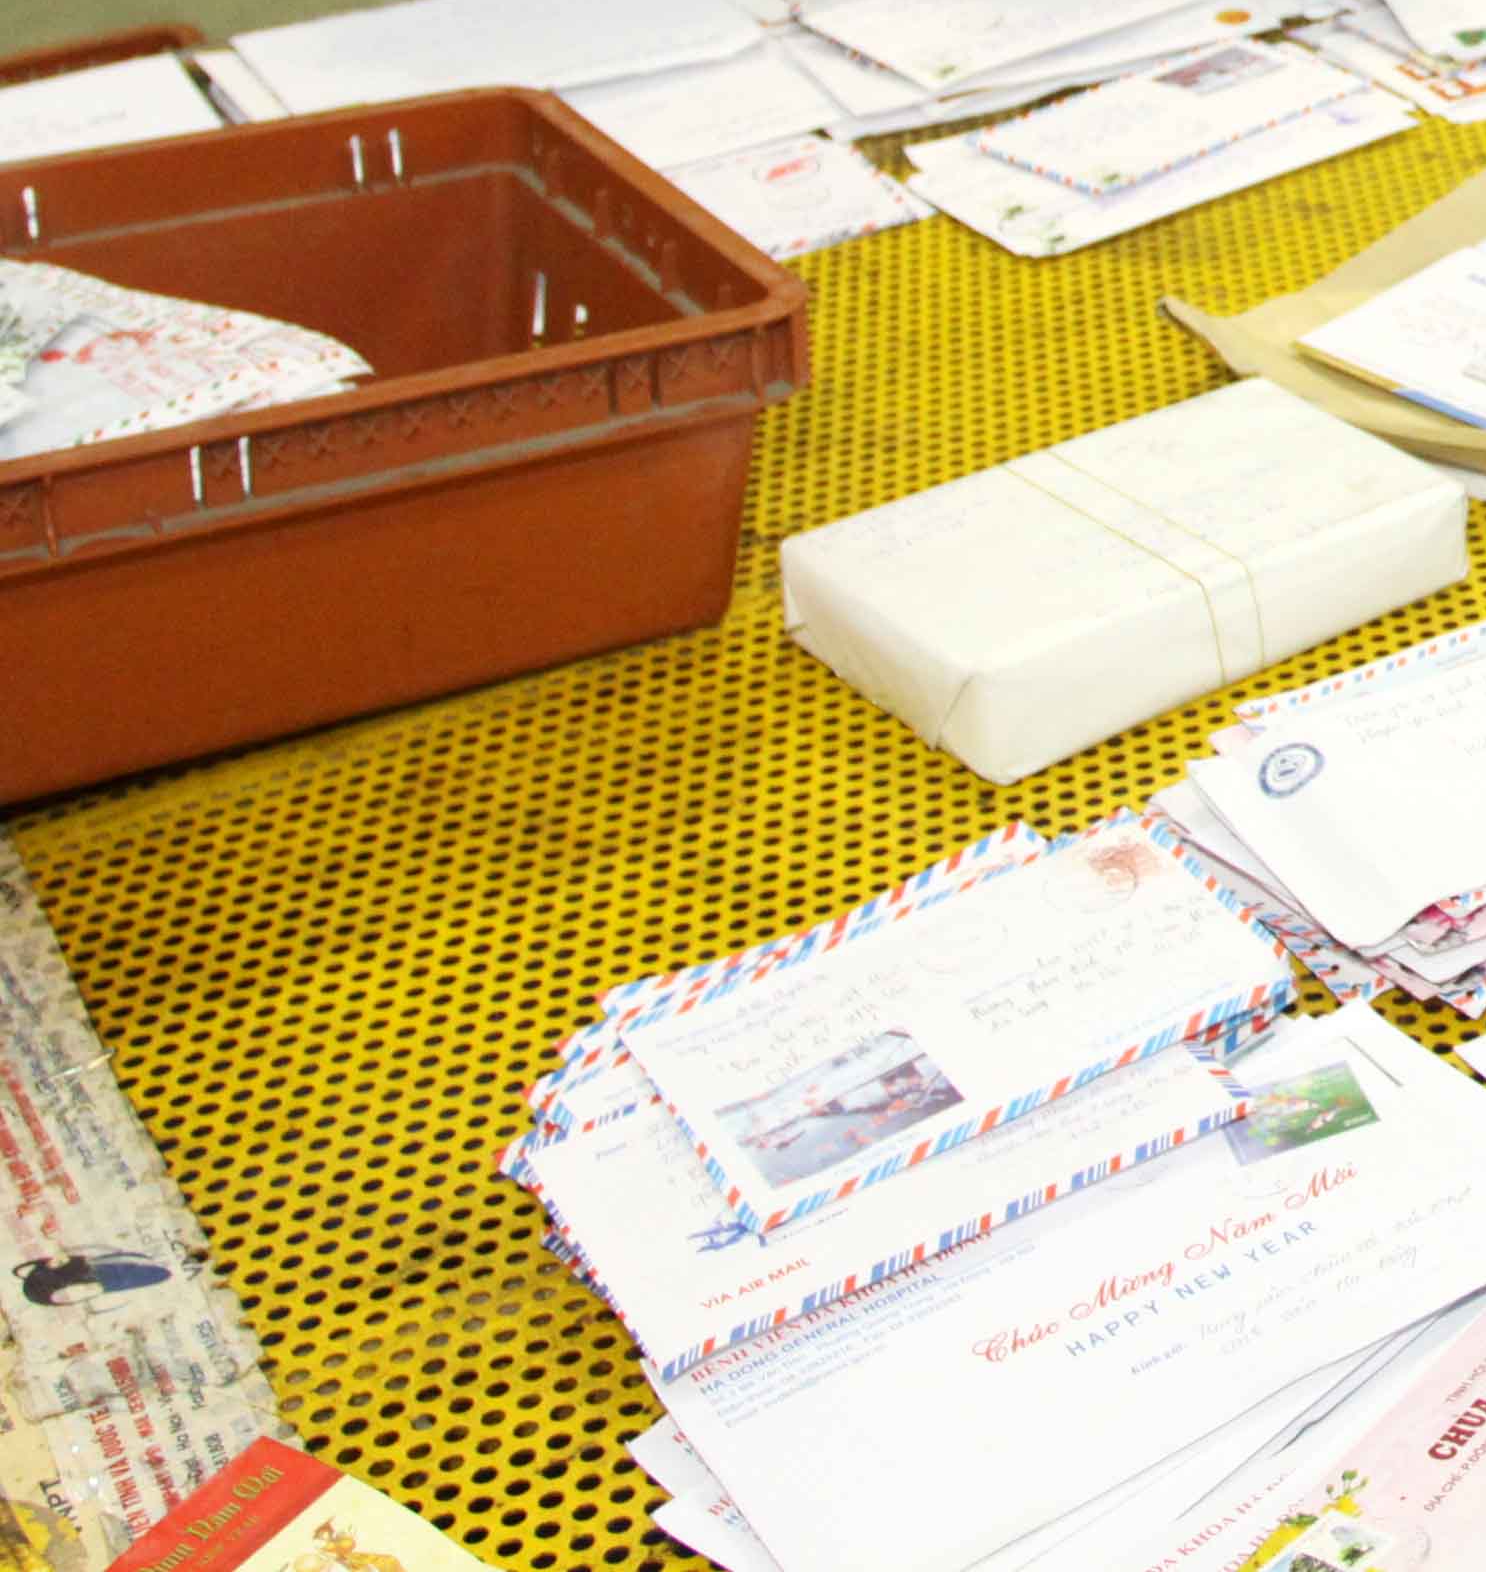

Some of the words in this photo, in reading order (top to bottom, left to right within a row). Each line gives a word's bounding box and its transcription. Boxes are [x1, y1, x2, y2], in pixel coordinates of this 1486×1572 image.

[700, 1294, 731, 1309] VIA
[737, 1279, 765, 1298] AIR
[768, 1258, 812, 1280] MAIL
[862, 1273, 940, 1315] HOSPITAL
[1065, 1299, 1161, 1357] HAPPY
[1175, 1263, 1235, 1301] NEW
[1244, 1219, 1318, 1263] YEAR
[971, 1318, 1060, 1364] Chúc
[40, 1479, 83, 1533] NPT
